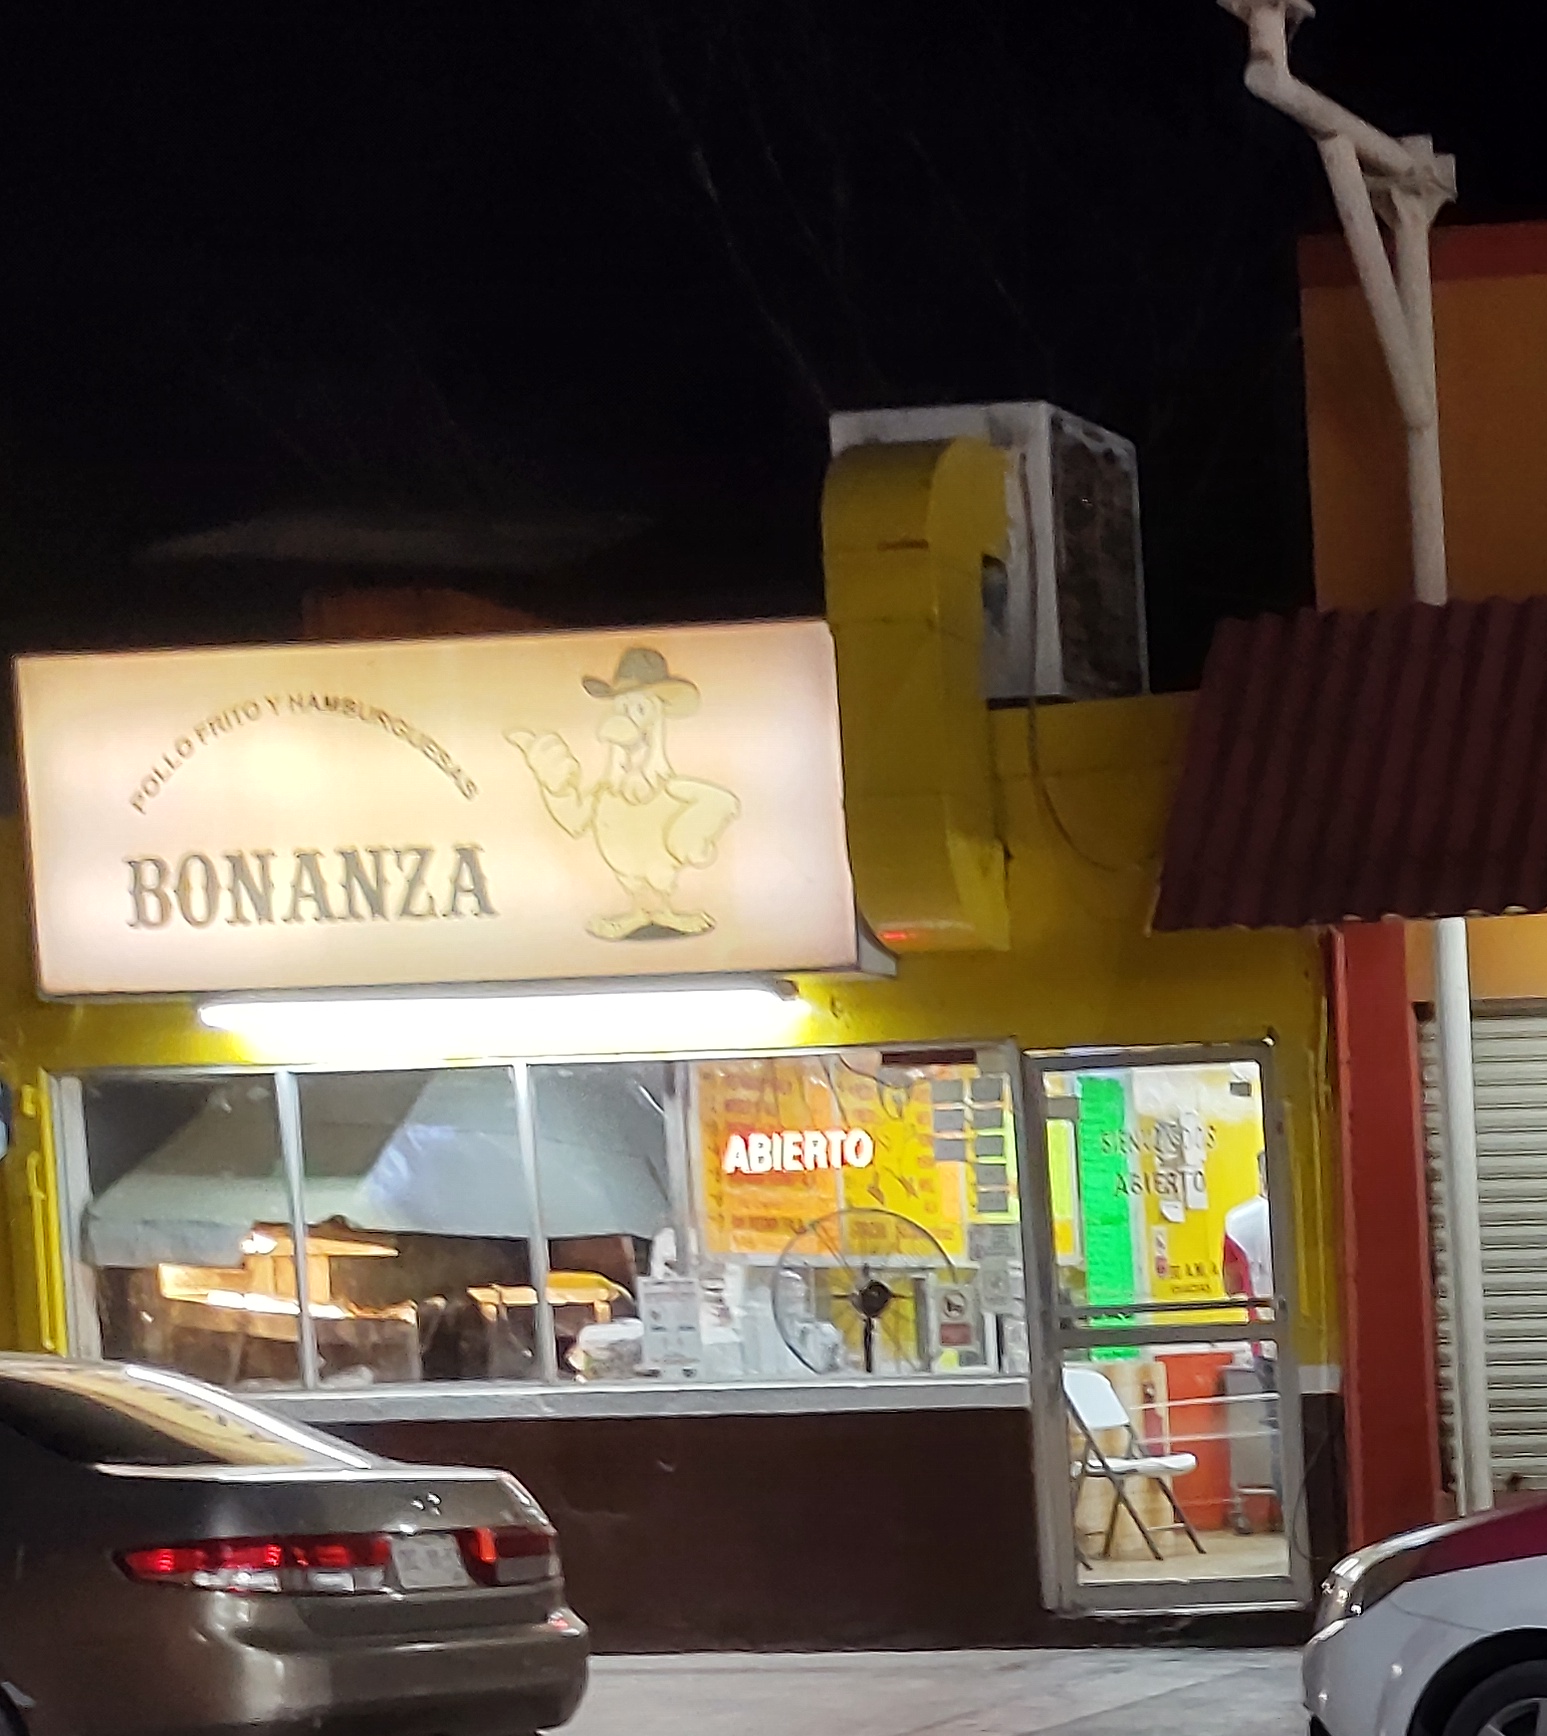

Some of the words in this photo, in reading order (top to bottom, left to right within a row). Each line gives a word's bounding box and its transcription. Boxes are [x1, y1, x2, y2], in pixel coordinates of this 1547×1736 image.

[129, 735, 195, 815] POLLO
[194, 699, 261, 746] FRITO
[264, 695, 280, 716] Y
[288, 691, 479, 801] HAMBURGUESAS
[125, 843, 500, 929] BONANZA
[722, 1126, 876, 1174] ABIERTO
